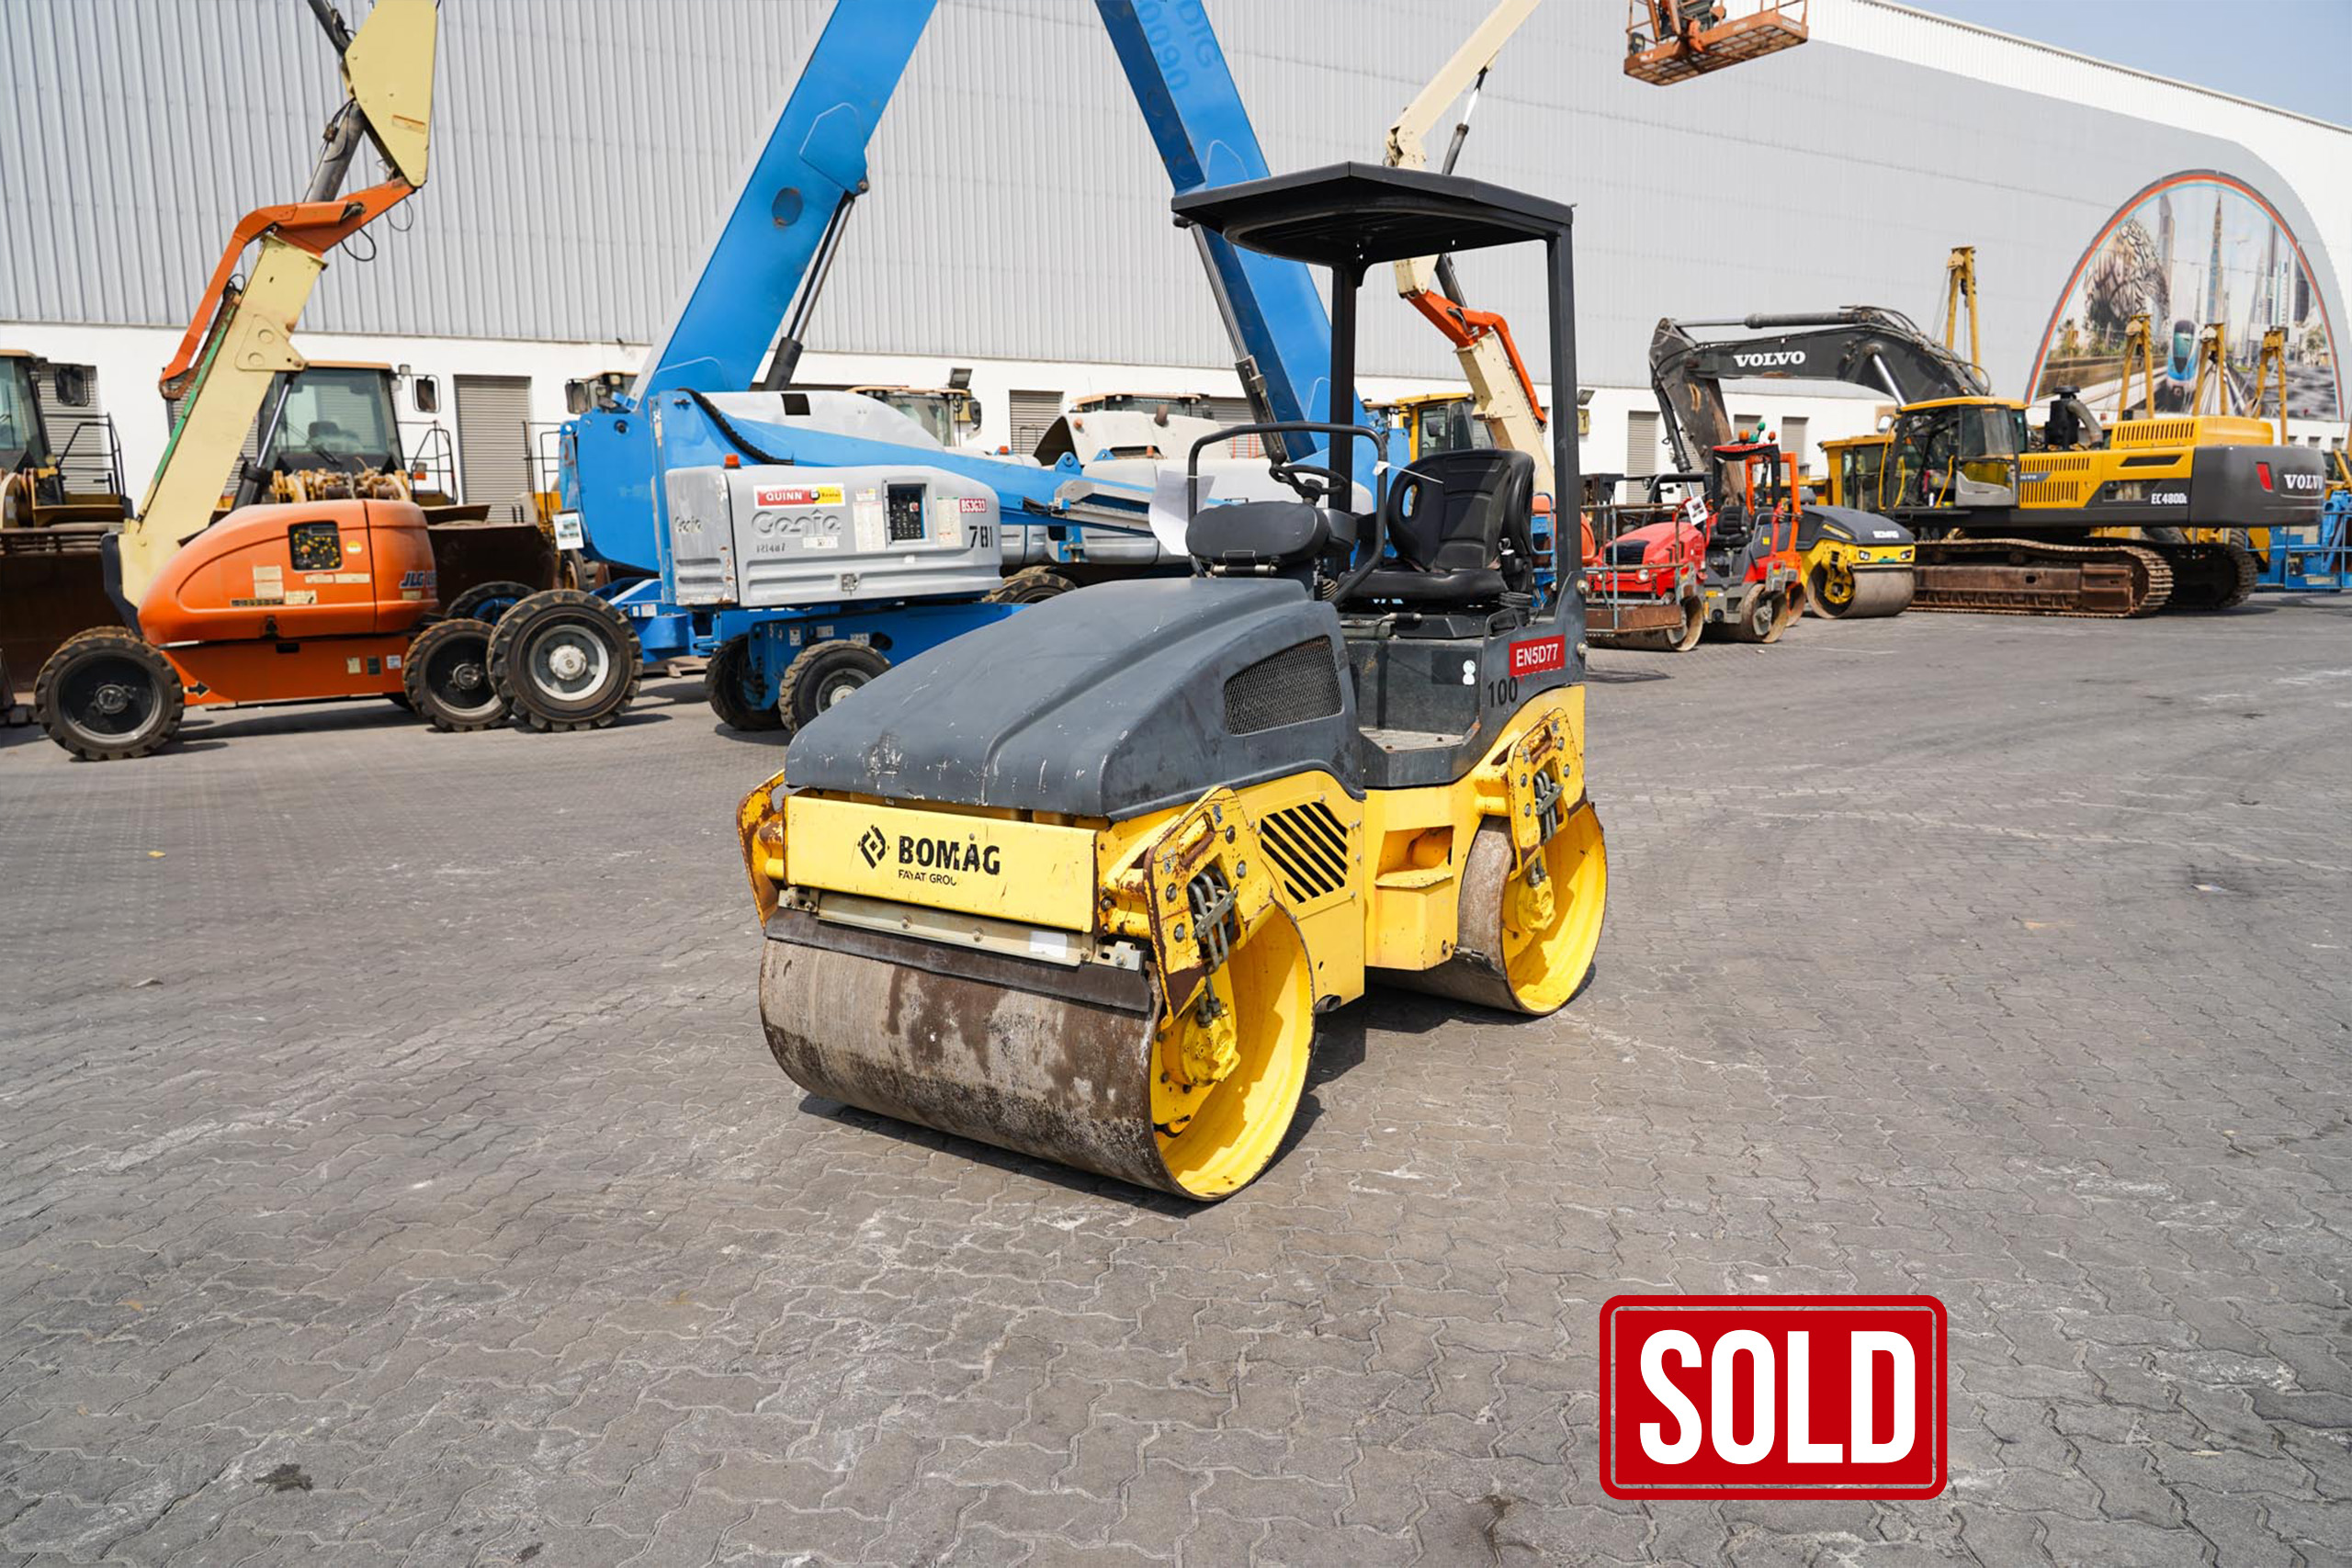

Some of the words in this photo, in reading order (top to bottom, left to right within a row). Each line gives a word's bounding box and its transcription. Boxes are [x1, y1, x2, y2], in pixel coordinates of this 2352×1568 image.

[1733, 350, 1806, 367] VOLVO
[766, 491, 803, 502] QUINN
[752, 509, 842, 539] Genie
[1516, 643, 1559, 668] EN5D77
[1487, 677, 1518, 708] 100
[899, 835, 1001, 875] BOMAG
